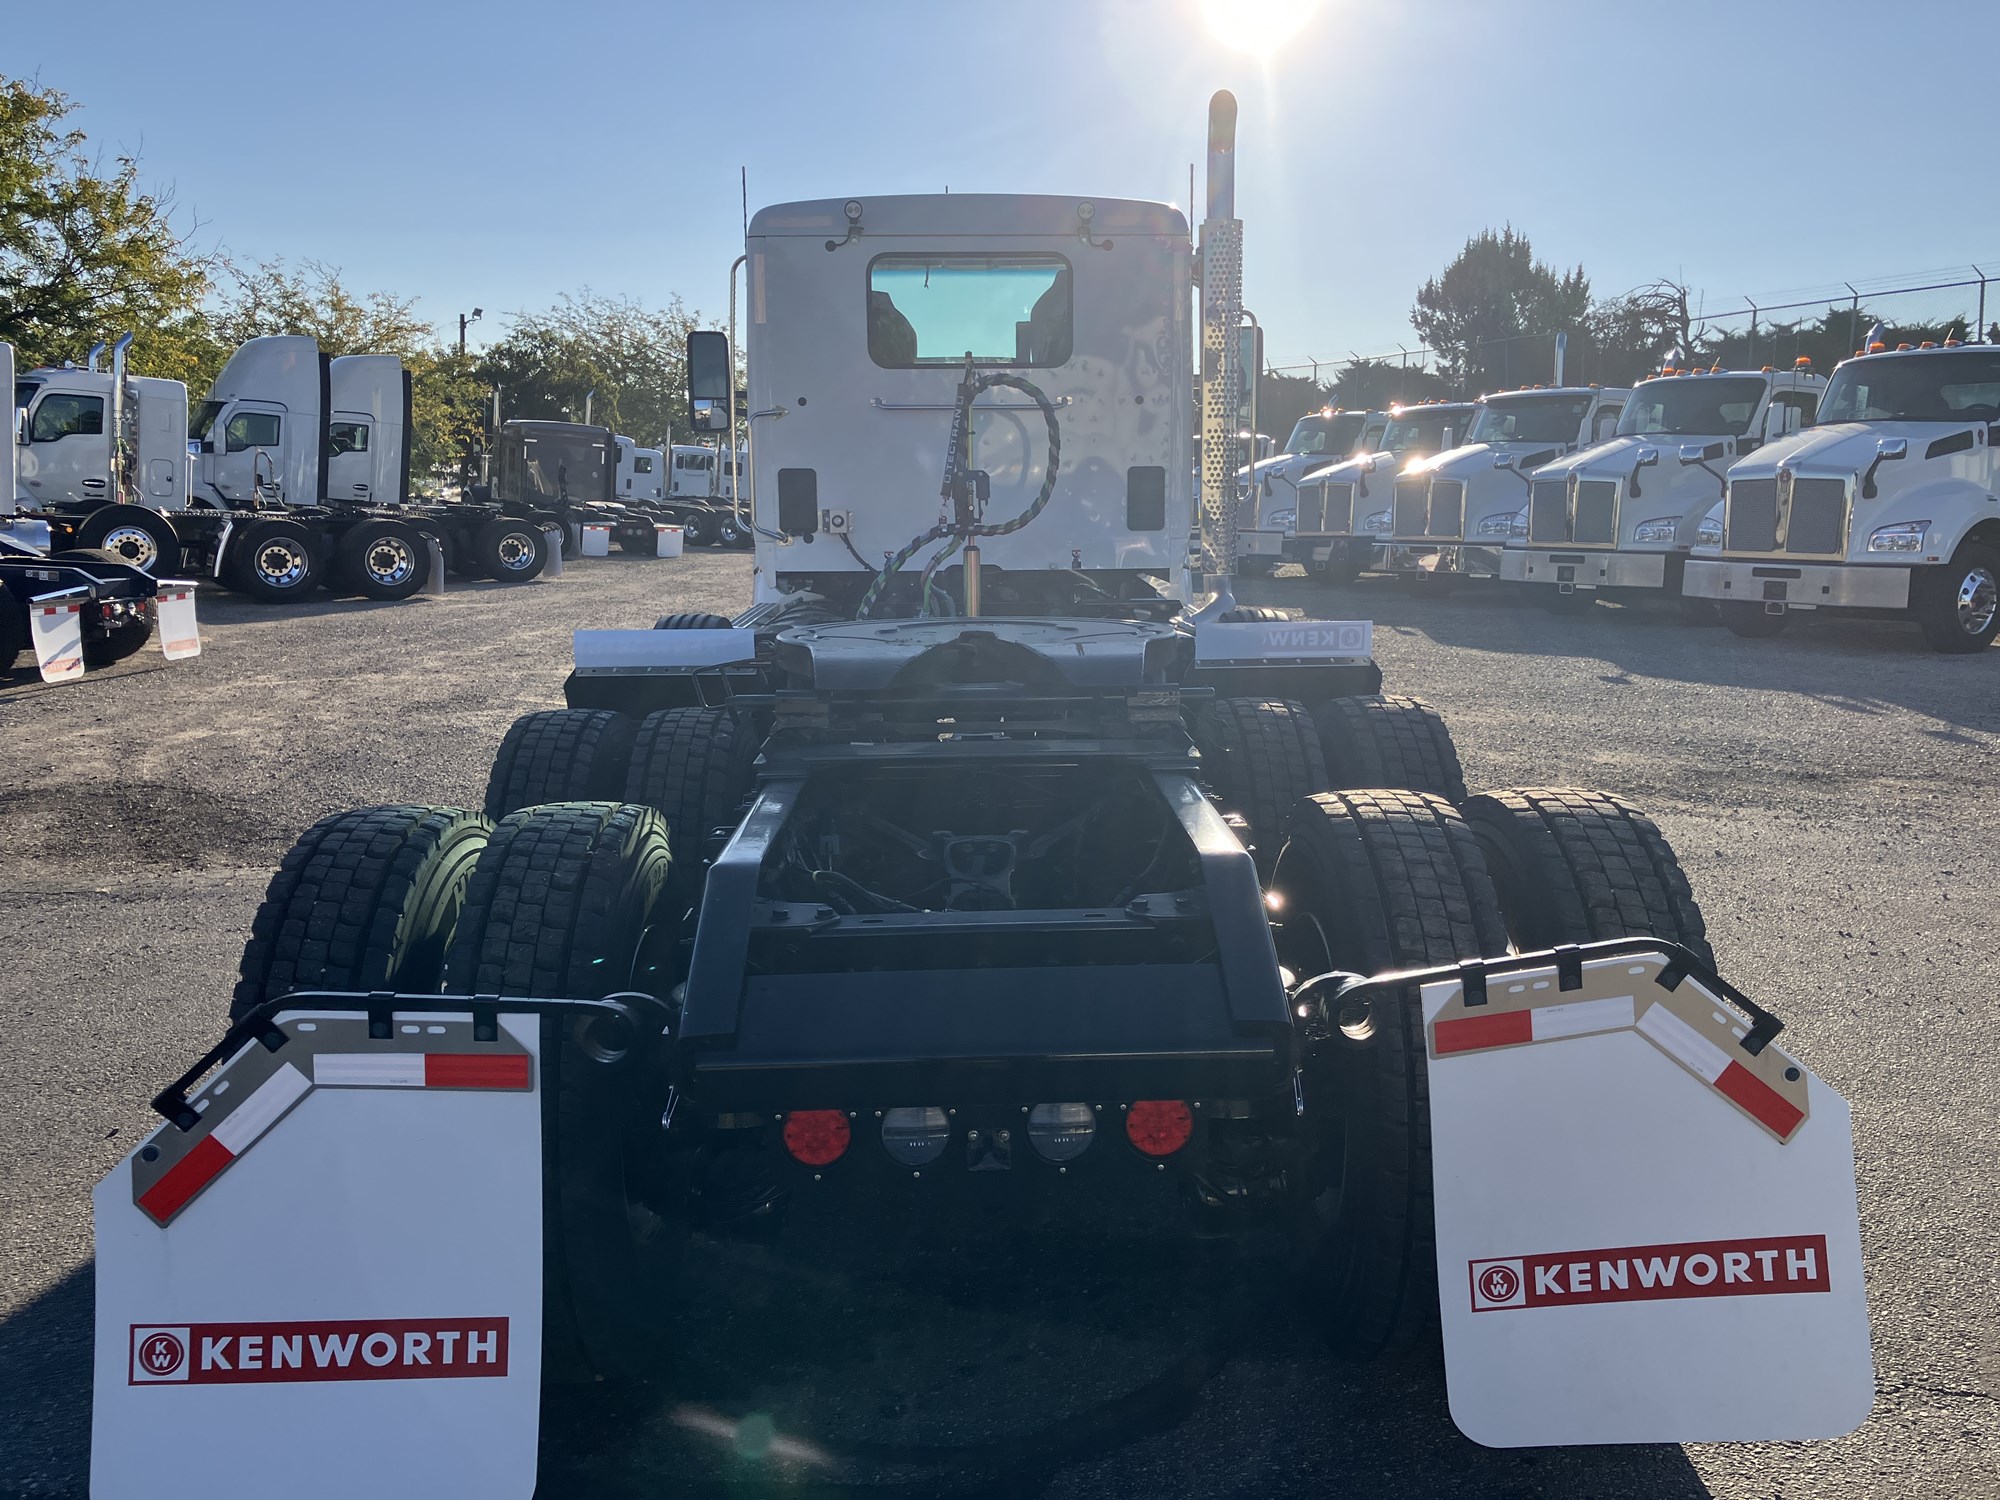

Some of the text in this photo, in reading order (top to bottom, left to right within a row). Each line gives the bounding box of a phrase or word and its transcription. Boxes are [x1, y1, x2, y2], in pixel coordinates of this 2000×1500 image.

[947, 410, 961, 469] TECTRAN
[1535, 1248, 1817, 1294] KENWORTH
[201, 1331, 497, 1369] KENWORTH
